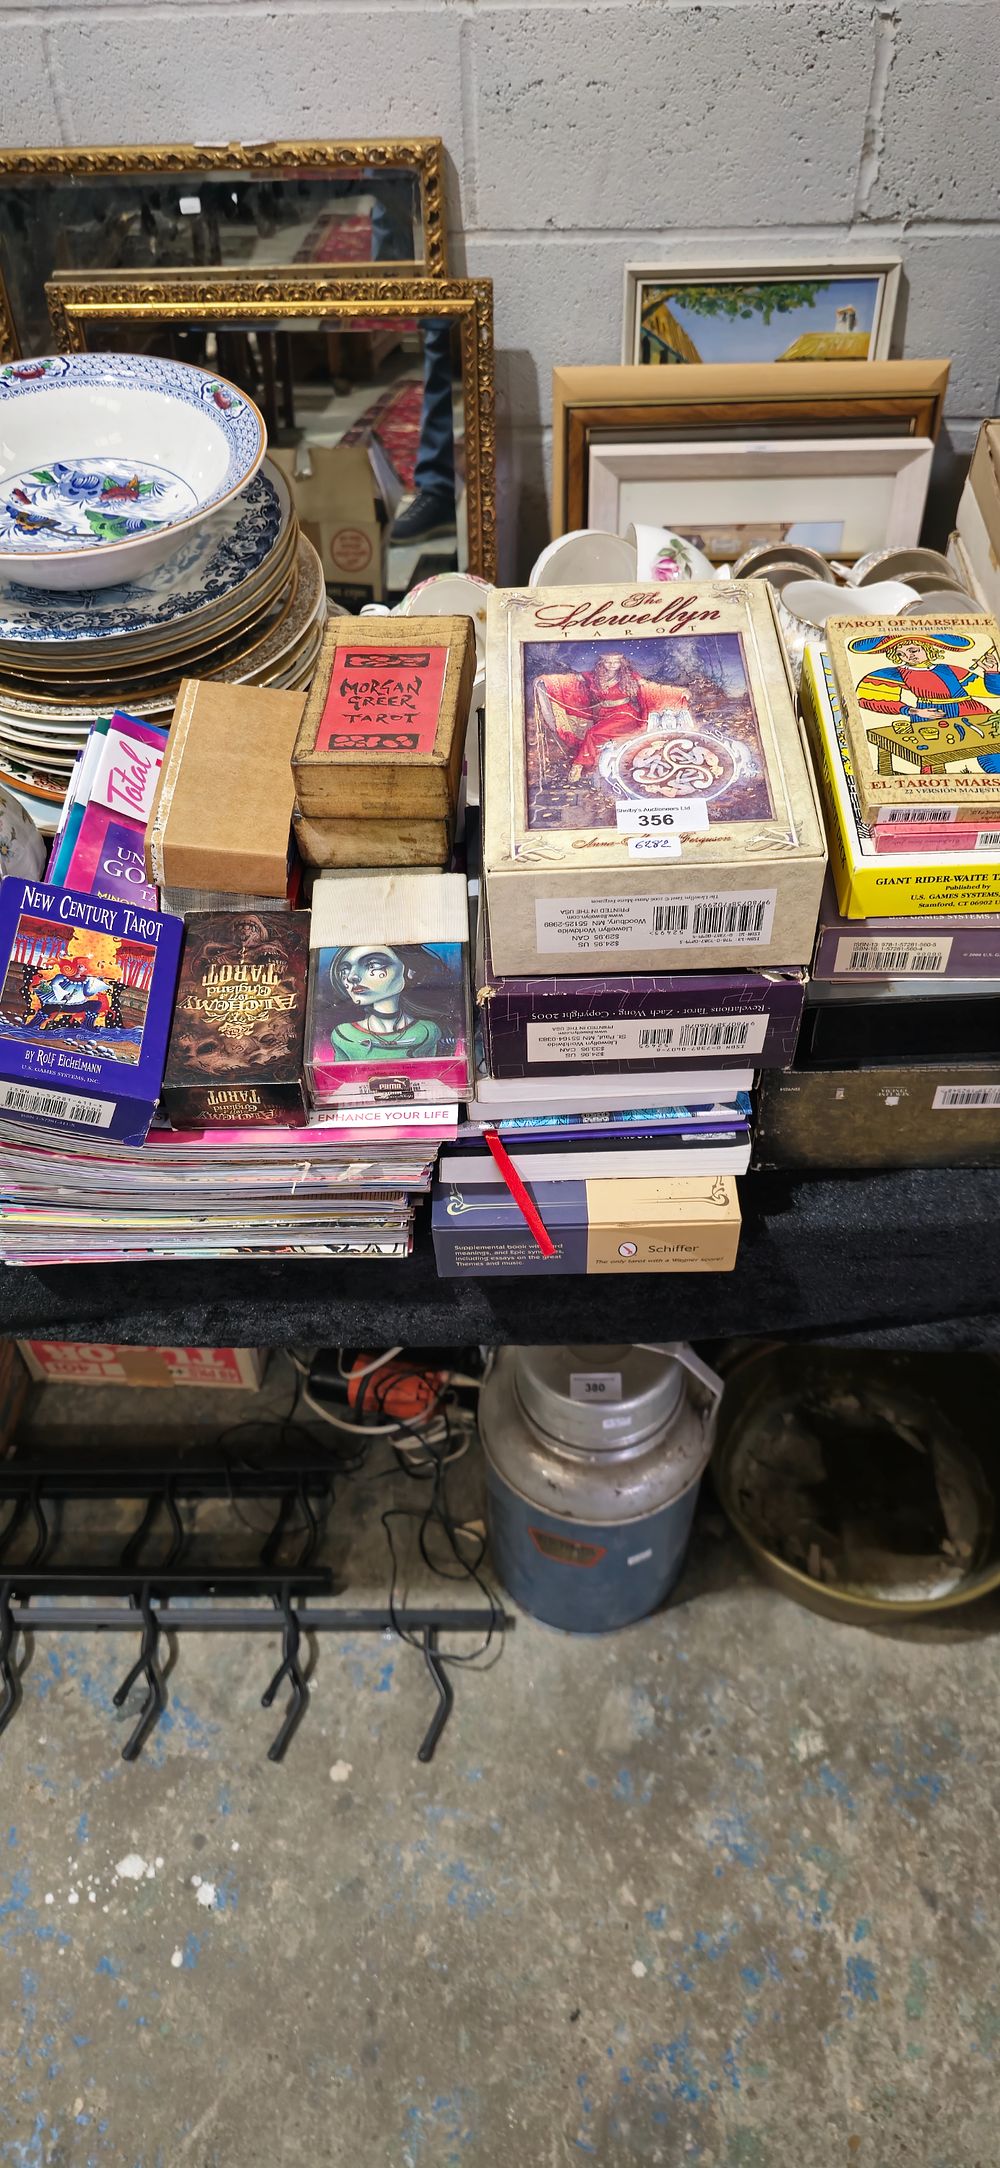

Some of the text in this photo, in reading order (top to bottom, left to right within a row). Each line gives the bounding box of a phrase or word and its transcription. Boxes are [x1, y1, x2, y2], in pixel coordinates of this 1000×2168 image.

[621, 591, 663, 608] The
[534, 595, 721, 634] Llewellyn
[834, 620, 884, 629] TAROT
[910, 619, 994, 627] MARSEILLE
[562, 625, 696, 638] TAROT
[339, 675, 423, 696] MORGAN
[348, 694, 416, 711] GREER
[343, 712, 422, 725] TAROT
[107, 740, 152, 813] Total
[871, 778, 1000, 790] EL TAROT MARS
[638, 814, 674, 826] 356
[679, 832, 732, 846] Ferguson
[117, 846, 146, 867] UN
[103, 859, 156, 889] GO
[876, 873, 989, 886] GIANT RIDER-WAITE
[140, 889, 157, 903] TA
[20, 885, 164, 942] NEW CENTURY TAROT
[202, 964, 279, 986] TAROT
[205, 983, 272, 996] England
[175, 992, 297, 1012] ALCHEMY
[711, 1004, 765, 1013] Revelations
[531, 1012, 559, 1020] 2005
[562, 1010, 609, 1019] Copyright
[650, 1009, 674, 1017] Zach
[683, 1007, 708, 1015] Tarot
[34, 1067, 56, 1076] GAMES
[57, 1072, 86, 1082] SYSTEMS,
[207, 1089, 261, 1105] TAROT
[213, 1103, 257, 1112] England
[317, 1110, 449, 1122] ENHANCE YOUR LIFE
[648, 1244, 700, 1253] Schiffer
[585, 1383, 606, 1393] 380
